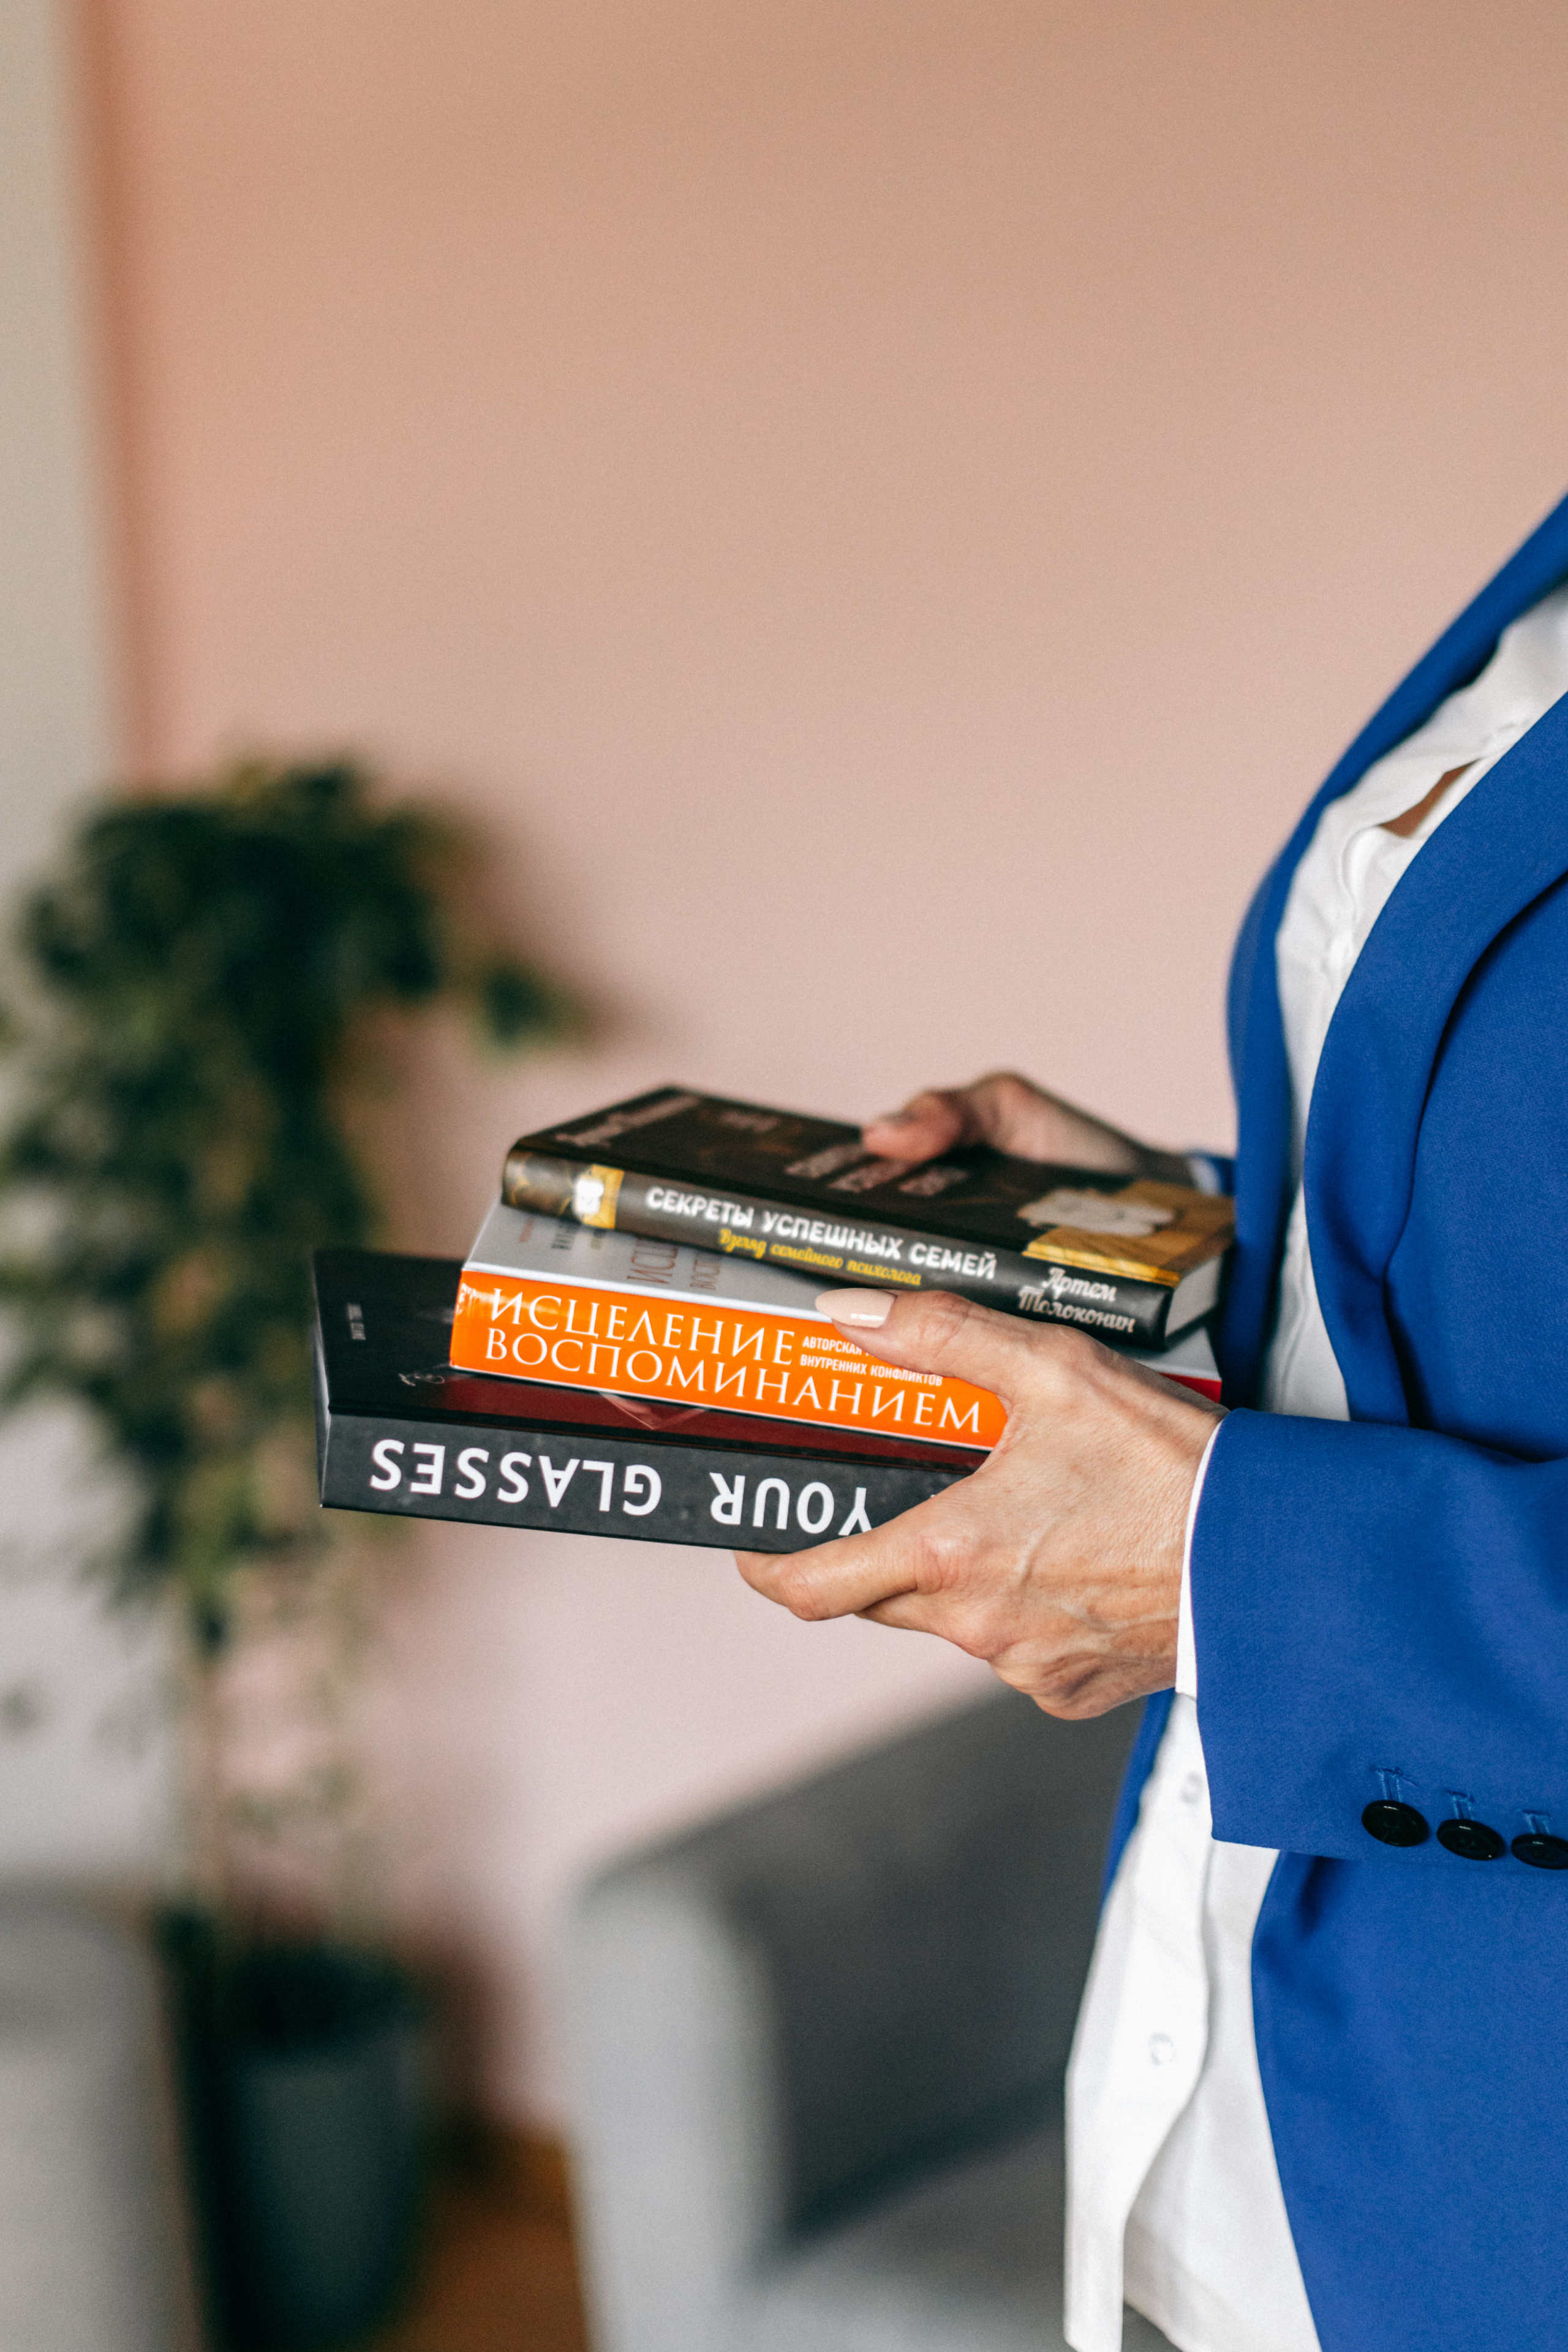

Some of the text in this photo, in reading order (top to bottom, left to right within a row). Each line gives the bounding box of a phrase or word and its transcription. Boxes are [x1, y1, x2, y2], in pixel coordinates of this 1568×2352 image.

[646, 1186, 998, 1280] СЕКРЕТЫ УСПЕШНЫХ СЕМЕЙ
[720, 1228, 922, 1286] Взгляд семейного психолога
[1019, 1286, 1136, 1333] Толоконин
[1042, 1267, 1117, 1302] Артем
[491, 1287, 795, 1366] ИСЦЕЛЕНИЕ
[484, 1327, 981, 1434] ВОСПОМИНАНИЕМ
[800, 1354, 943, 1387] ВНУТРЕННИХ КОНФЛИКТОВ
[369, 1439, 873, 1536] YOUR GLASSES
